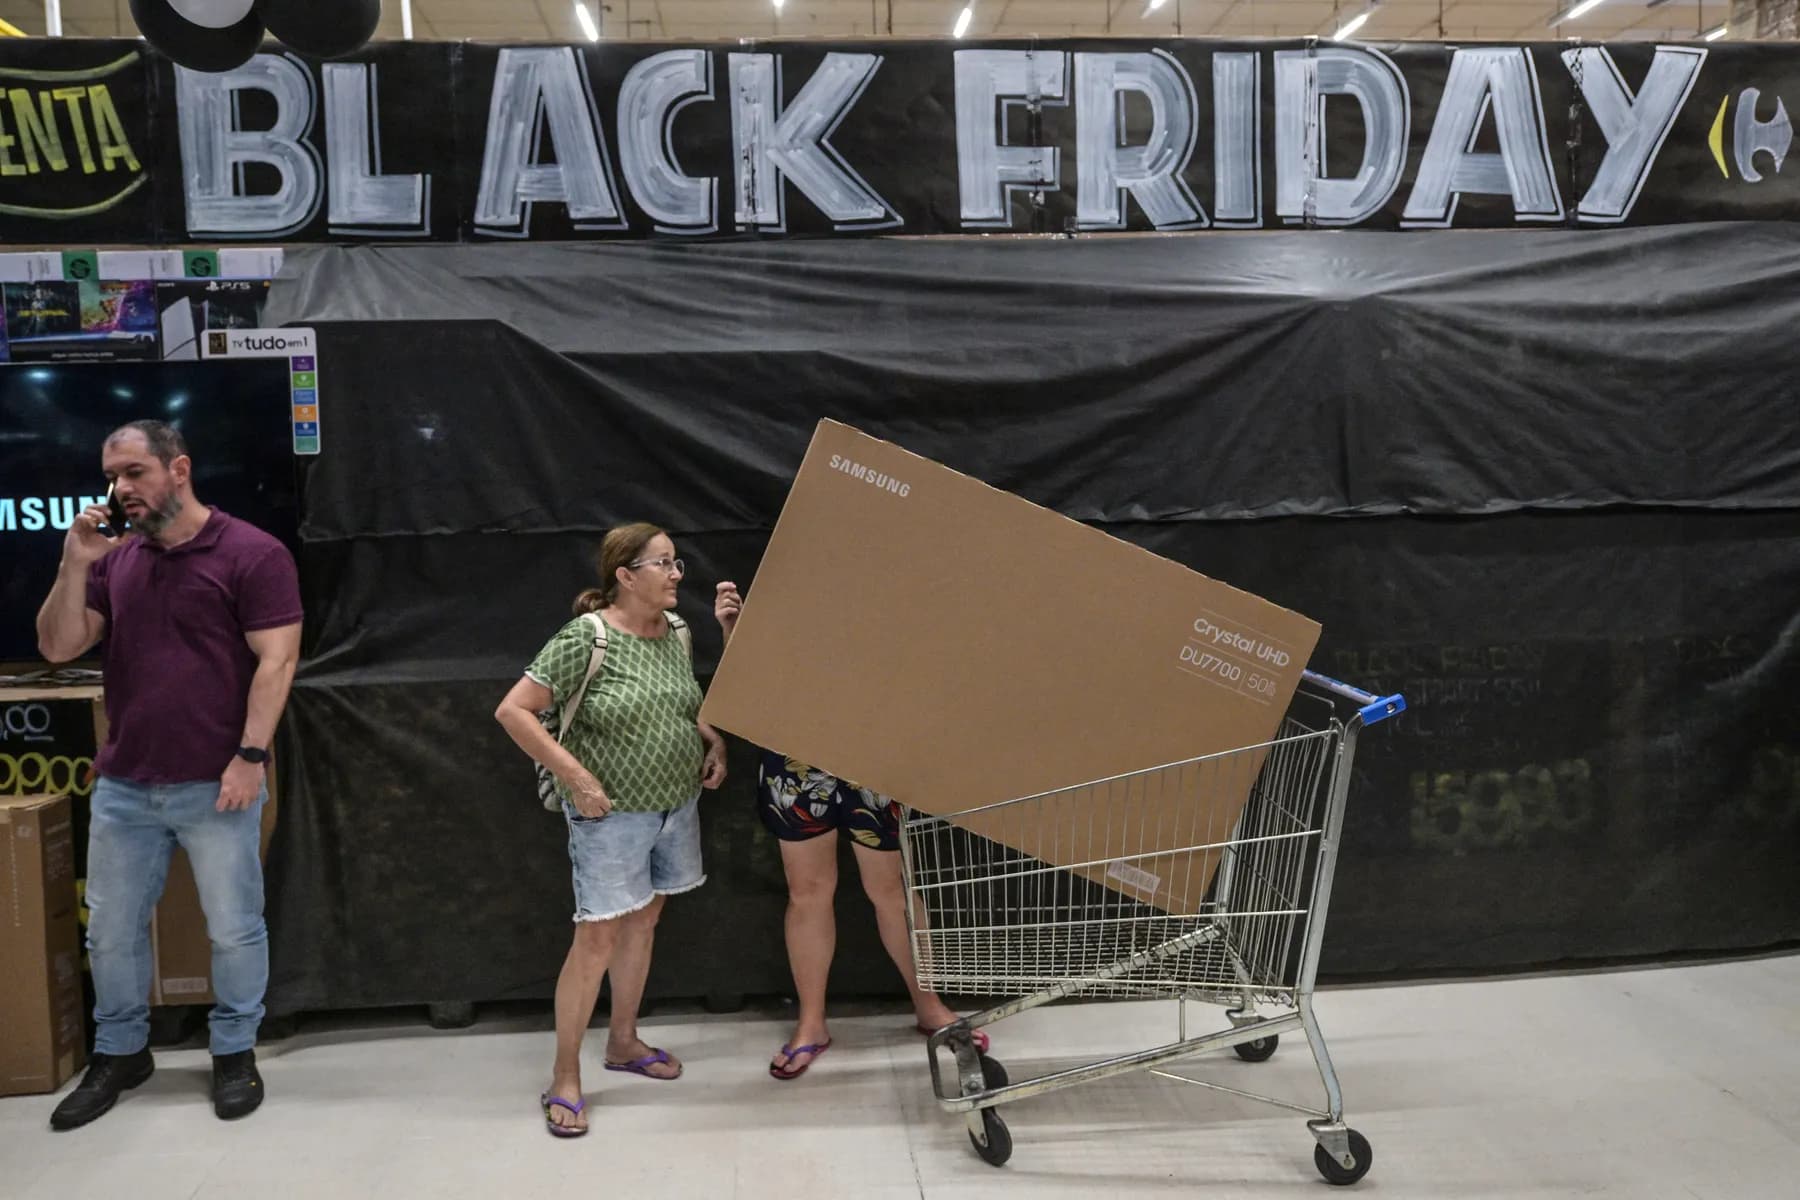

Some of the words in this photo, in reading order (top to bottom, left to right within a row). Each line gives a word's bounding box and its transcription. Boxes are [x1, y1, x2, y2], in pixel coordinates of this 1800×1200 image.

[175, 46, 904, 238] BLACK
[954, 45, 1708, 231] FRIDAY
[244, 335, 287, 351] tudo
[829, 454, 911, 498] SAMSUNG
[1179, 645, 1241, 681] DU7700
[1193, 618, 1256, 654] Crystal
[1256, 643, 1290, 667] UHD
